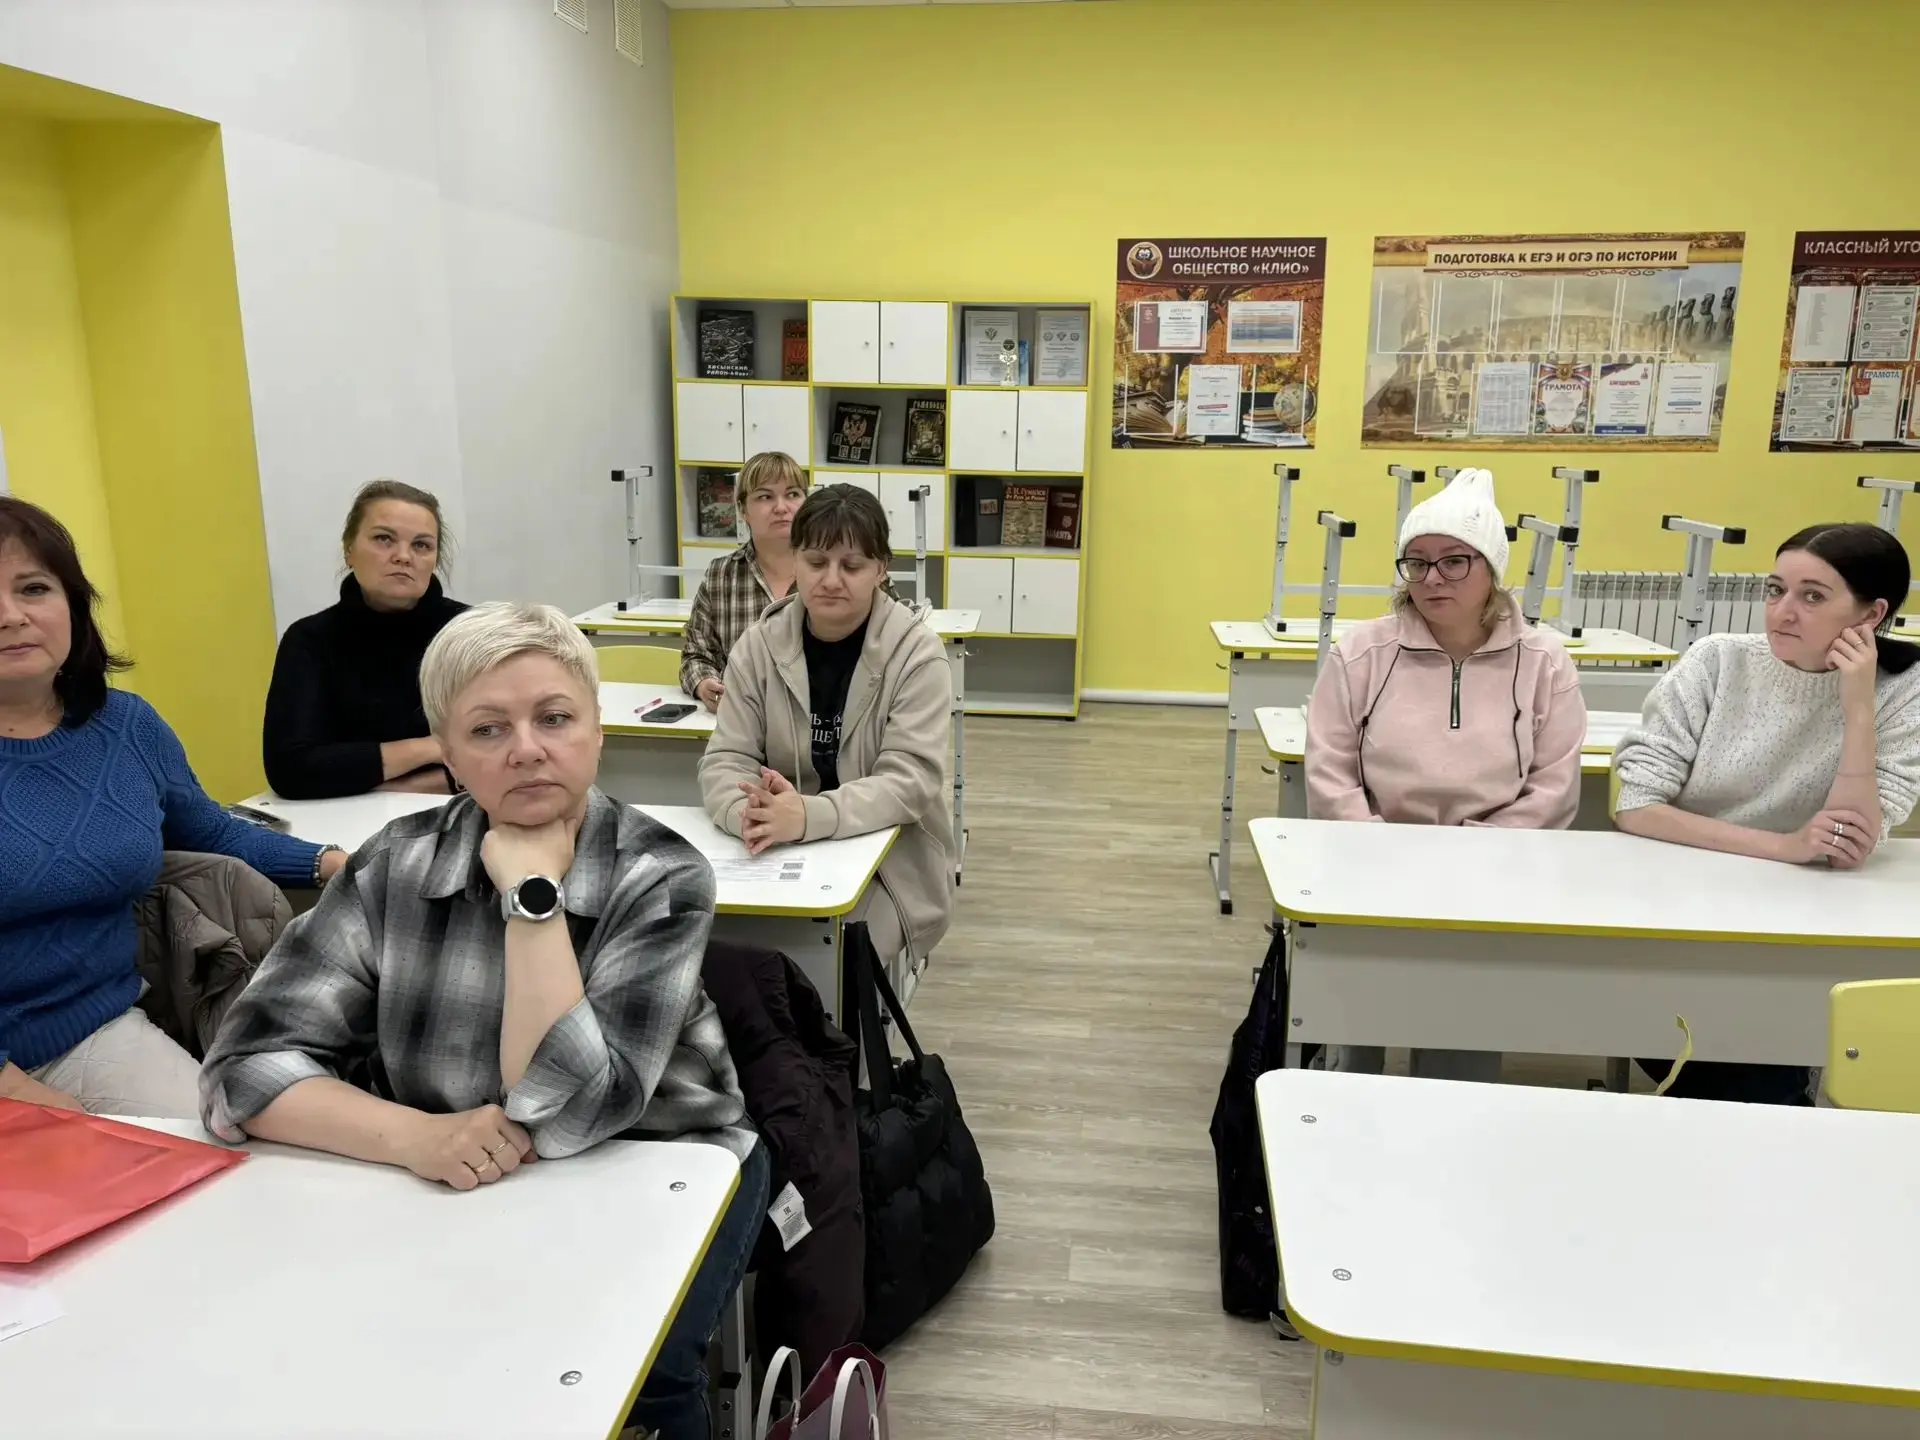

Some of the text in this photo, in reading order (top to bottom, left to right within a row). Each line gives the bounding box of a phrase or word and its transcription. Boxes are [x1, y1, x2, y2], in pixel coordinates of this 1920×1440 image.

[1168, 245, 1316, 259] ШКОЛЬНОЕ НАУЧНОЕ
[1804, 238, 1890, 254] КЛАССНЫЙ
[1434, 251, 1678, 265] ПОДГОТОВКА К ЕГЭ И ОГЭ ПО ИСТОРИИ
[1172, 262, 1310, 277] ОБЩЕСТВО «КЛИО»
[1863, 371, 1900, 379] ГРАМОТА
[1544, 383, 1583, 391] ГРАМОТА
